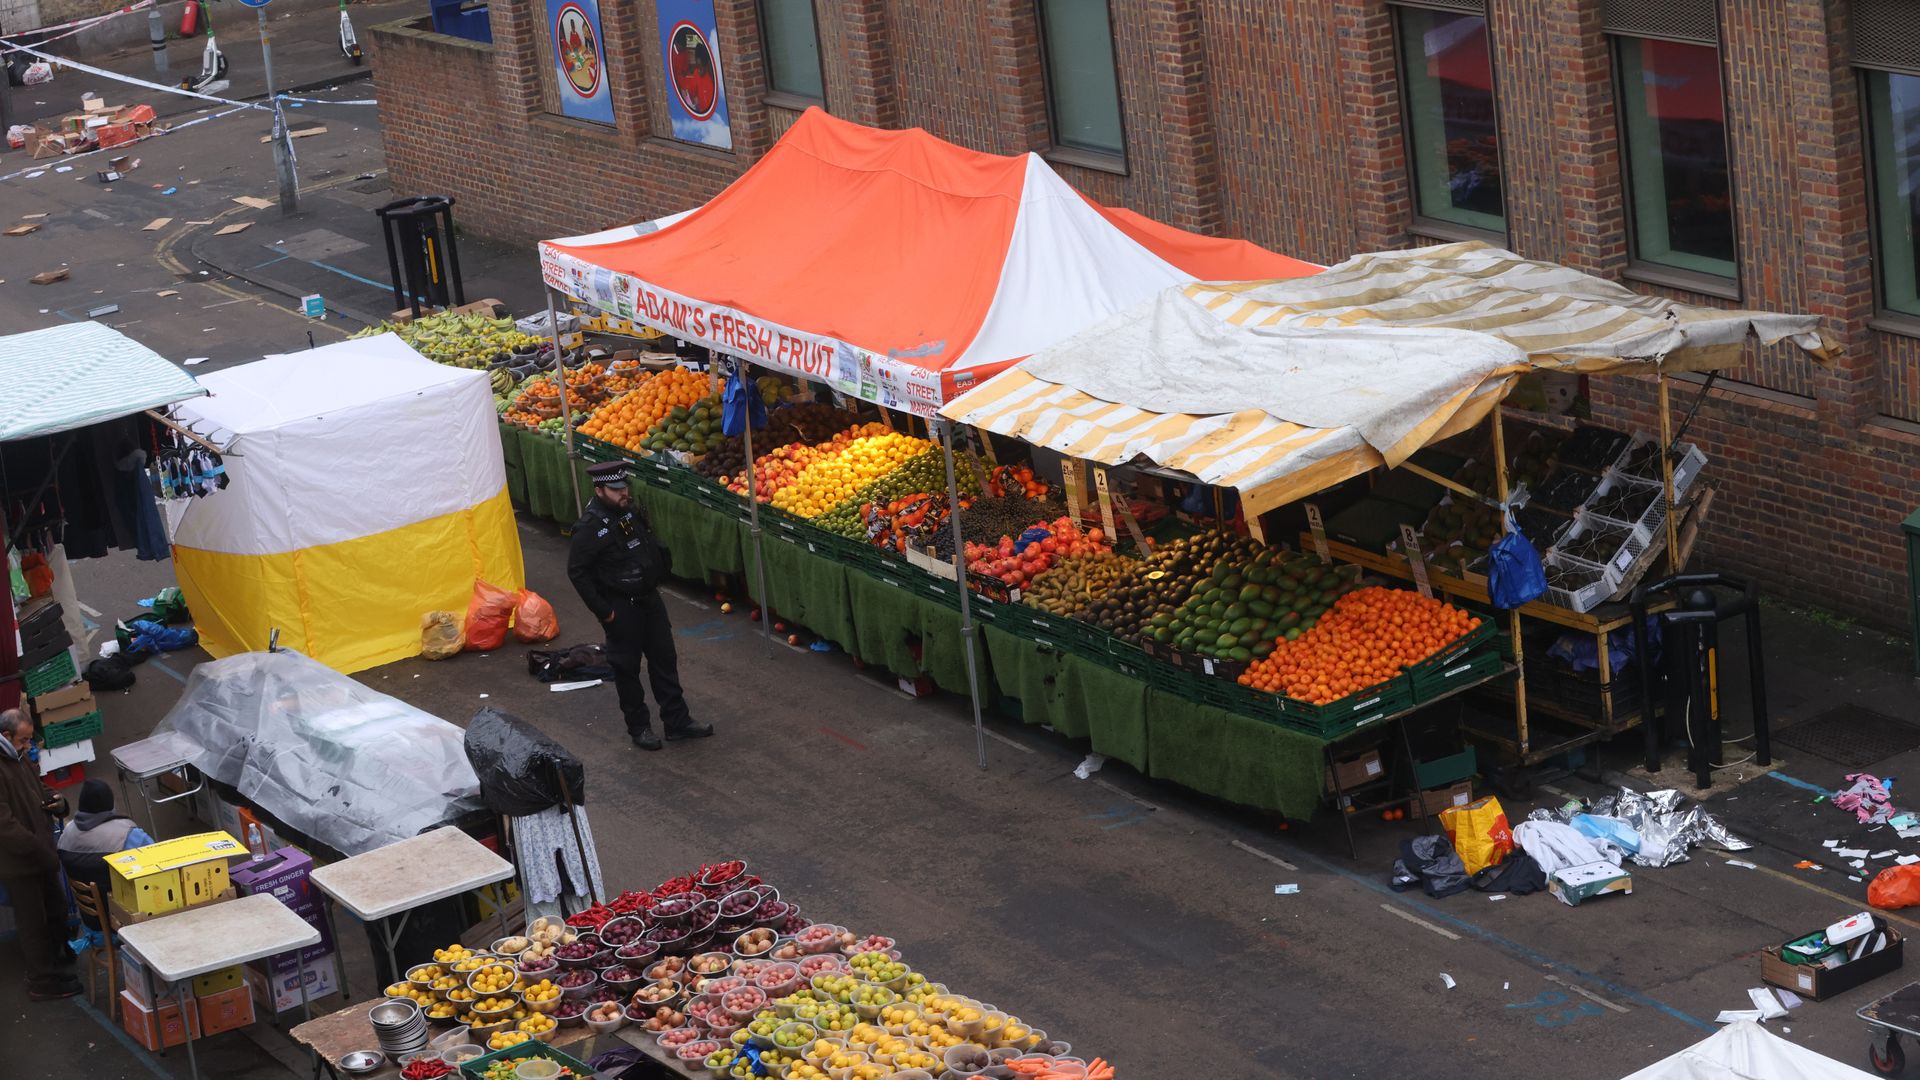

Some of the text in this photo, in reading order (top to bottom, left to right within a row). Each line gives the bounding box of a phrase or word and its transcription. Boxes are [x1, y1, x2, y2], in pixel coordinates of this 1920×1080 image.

[542, 261, 566, 278] STREET
[636, 287, 706, 338] ADAM'S
[709, 312, 772, 360] FRESH
[777, 333, 834, 377] FRUIT
[911, 366, 931, 380] EAST
[906, 381, 936, 400] STREET
[957, 378, 977, 389] EAST
[1098, 473, 1104, 485] 2
[1310, 508, 1318, 520] 2
[1405, 528, 1413, 542] 8
[255, 879, 278, 892] FRESH
[279, 869, 305, 883] GINGER
